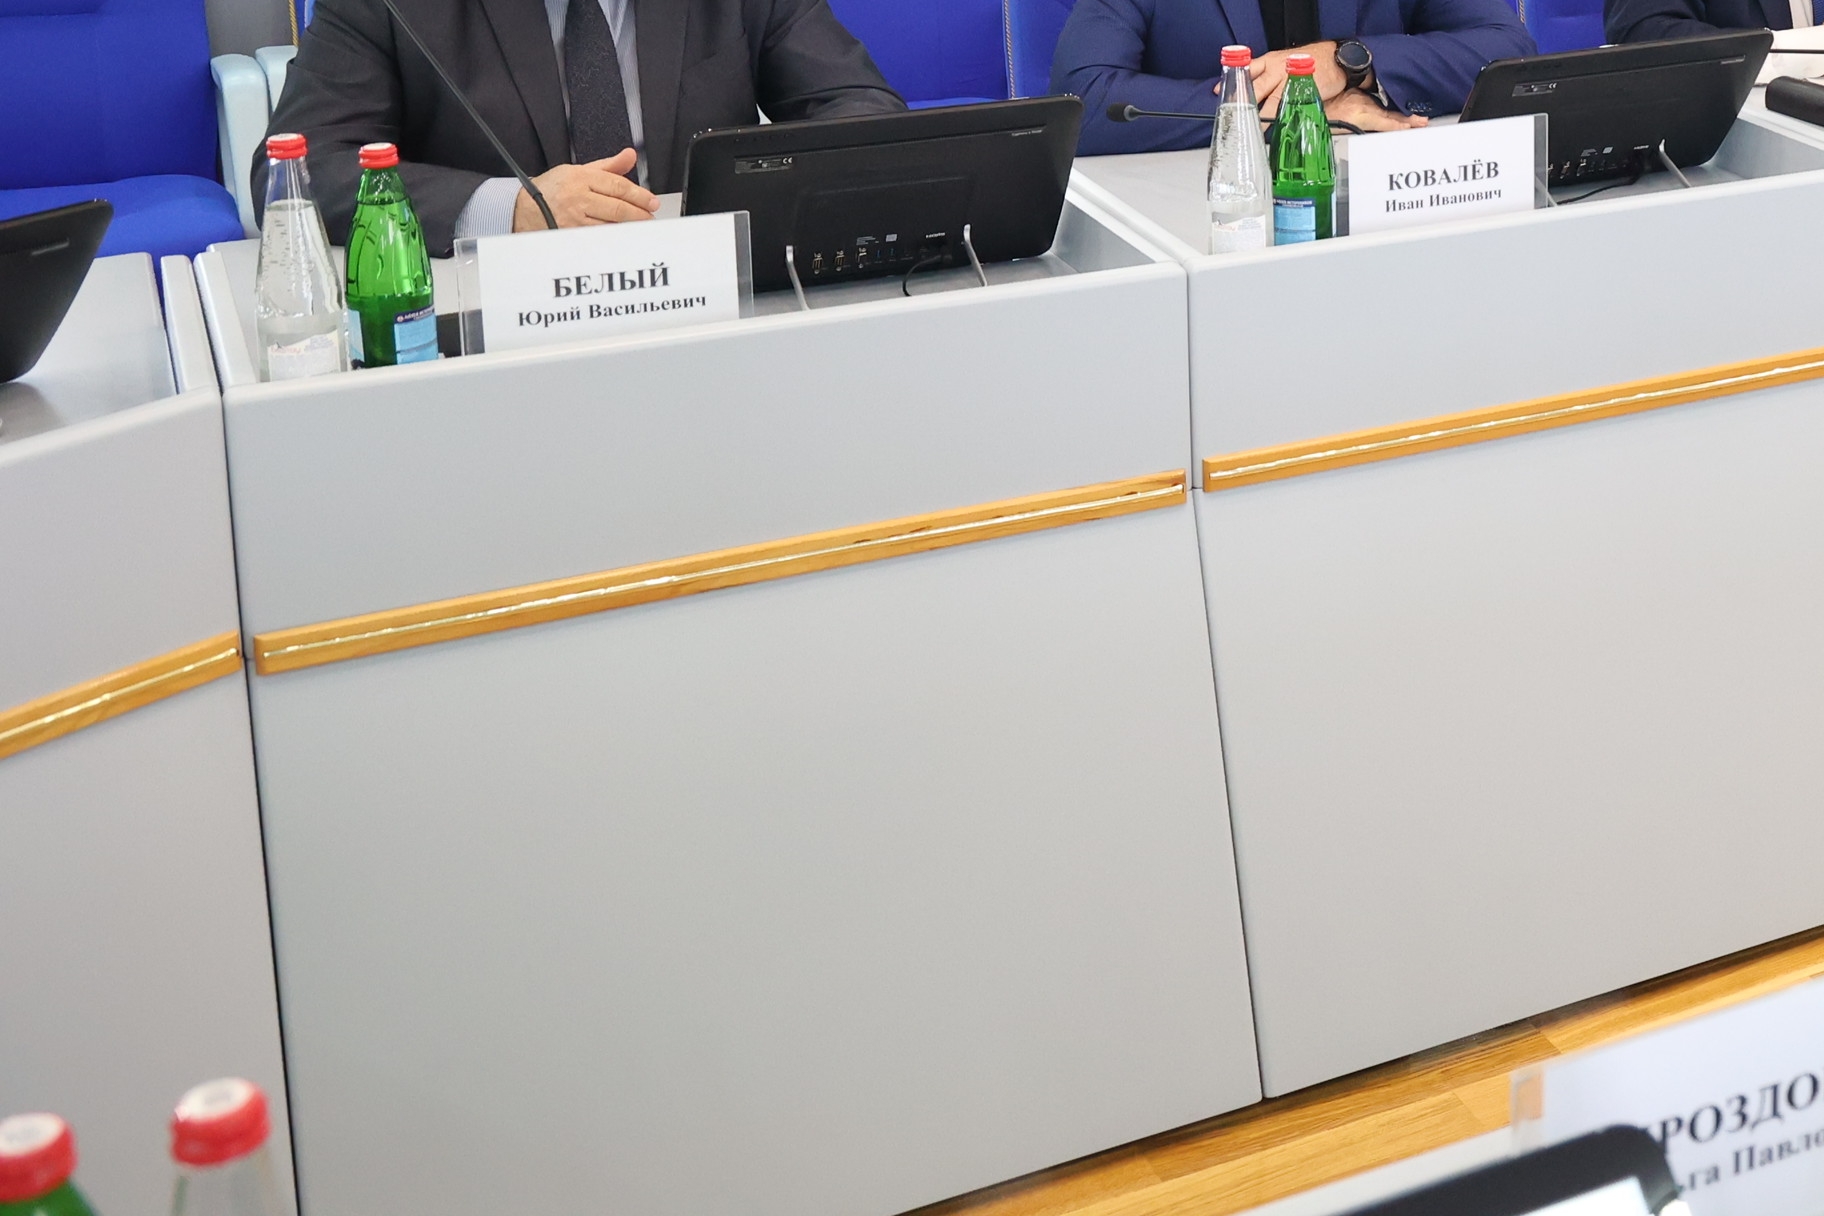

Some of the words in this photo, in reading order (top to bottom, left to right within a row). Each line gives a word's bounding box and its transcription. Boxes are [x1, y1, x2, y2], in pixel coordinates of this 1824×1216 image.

[1388, 158, 1500, 191] КОВАЛЁВ
[1385, 199, 1424, 213] Иван
[1429, 189, 1502, 208] Иванович
[552, 261, 671, 299] БЕЛЫЙ
[517, 306, 582, 328] Юрий
[588, 295, 707, 319] Васильевич
